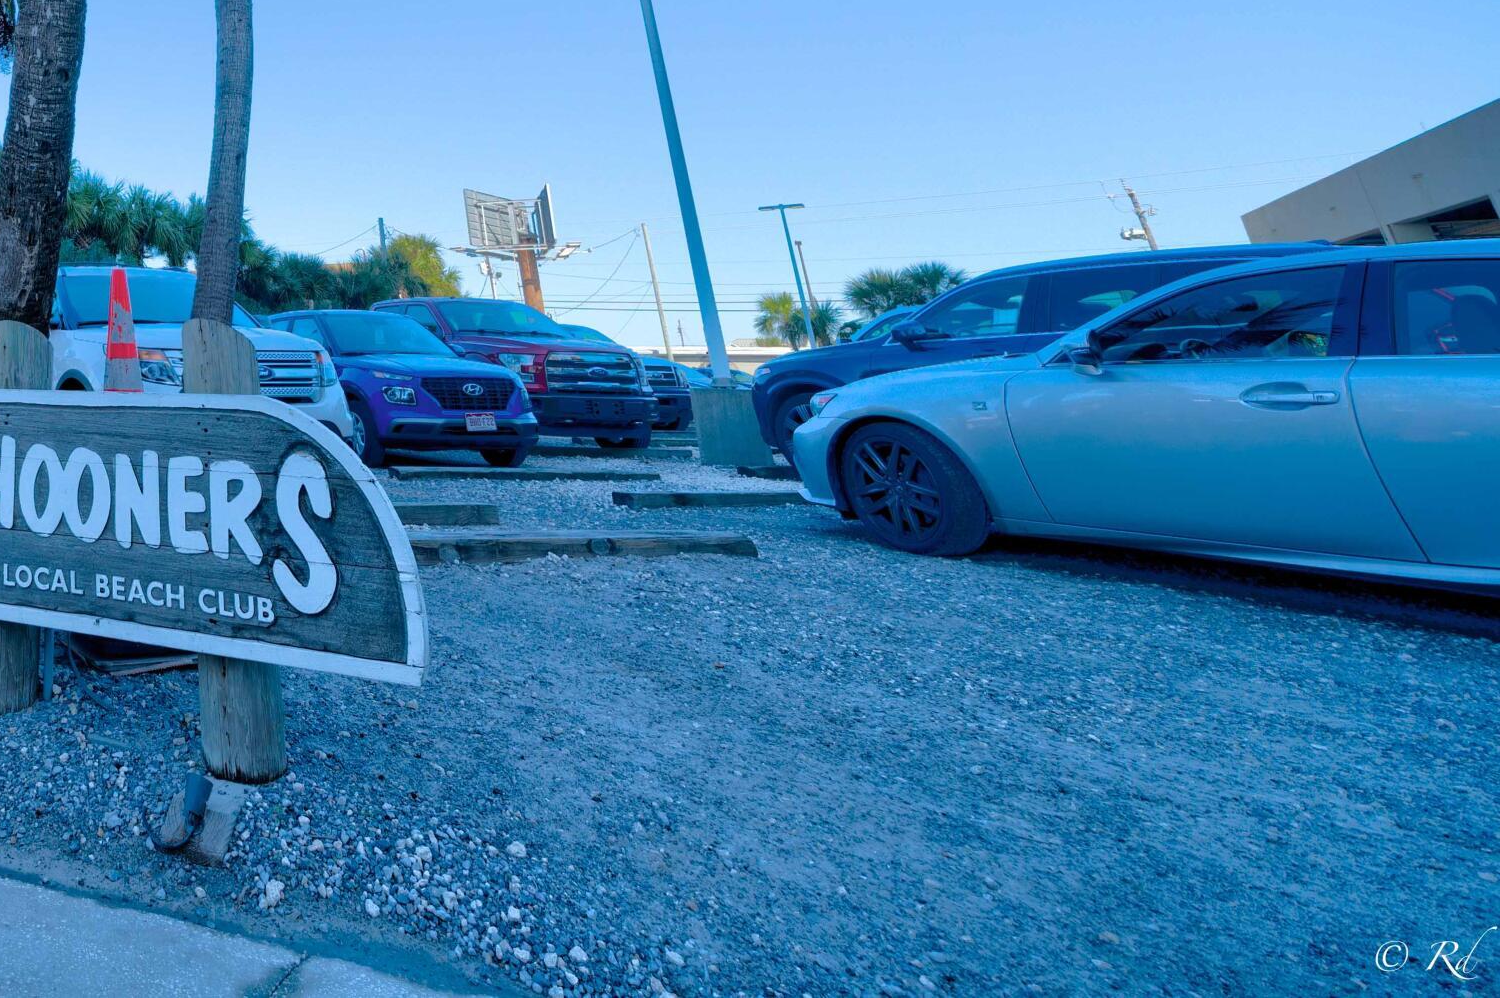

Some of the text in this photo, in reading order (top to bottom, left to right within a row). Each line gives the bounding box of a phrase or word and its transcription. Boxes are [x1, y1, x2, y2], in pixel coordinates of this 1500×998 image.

[3, 563, 84, 596] LOCAL
[95, 573, 186, 610] BEACH
[198, 588, 276, 624] CLUB
